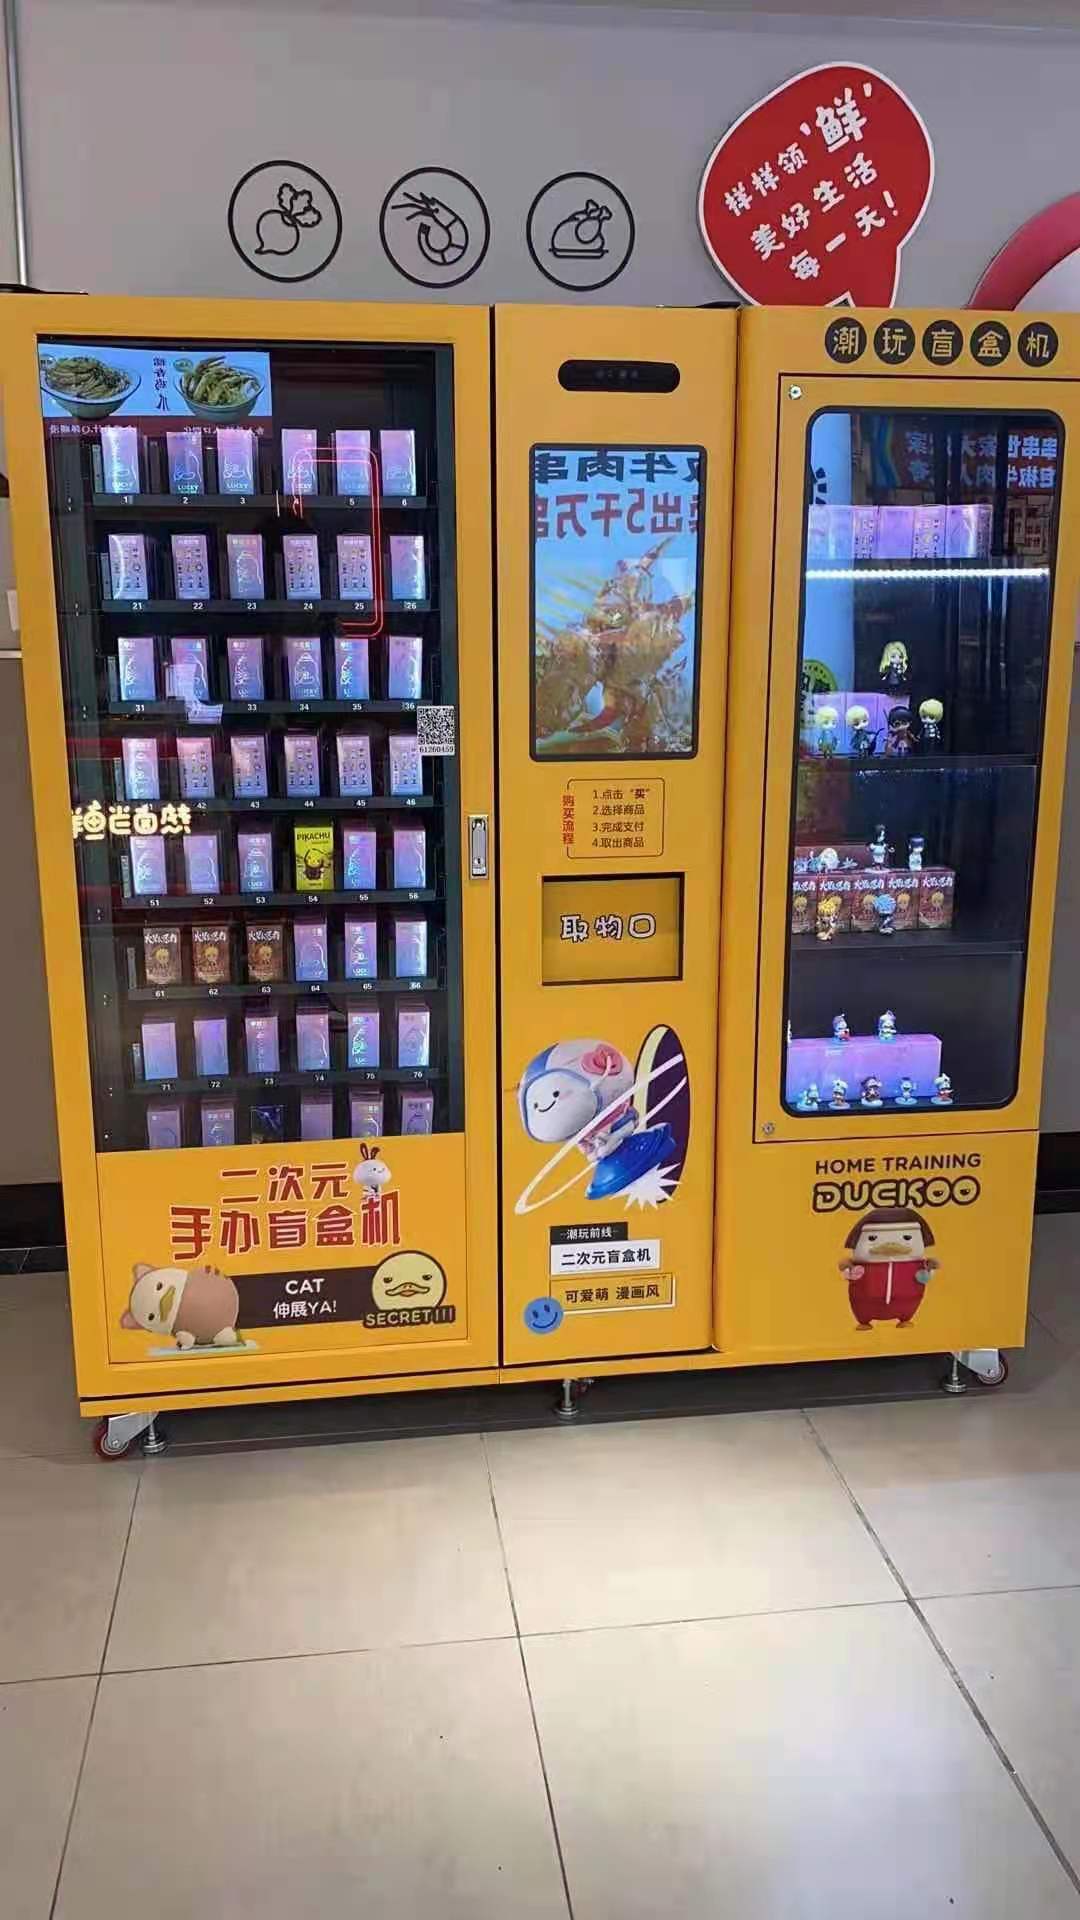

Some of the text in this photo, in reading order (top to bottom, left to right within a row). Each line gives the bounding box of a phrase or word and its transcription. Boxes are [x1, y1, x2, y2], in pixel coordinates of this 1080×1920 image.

[750, 152, 878, 260] 美好生活
[832, 322, 1052, 361] 潮玩盲盒机
[562, 794, 575, 845] 购买流程
[592, 804, 646, 816] 2.选择商品
[296, 832, 330, 840] PIKACHU
[592, 821, 645, 833] 3.完成支付
[592, 836, 645, 848] 4.取出商品
[560, 912, 657, 943] 取物口
[815, 1153, 982, 1175] HOME TRAINING
[221, 1160, 350, 1206] 二次元
[812, 1175, 981, 1213] DUCKOO
[169, 1189, 401, 1263] 手办盲盒机
[561, 1248, 652, 1267] 二次元盲盒机
[284, 1278, 326, 1296] CAT
[565, 1284, 660, 1304] 可爱萌 漫画风
[272, 1300, 338, 1321] 伸展YA!
